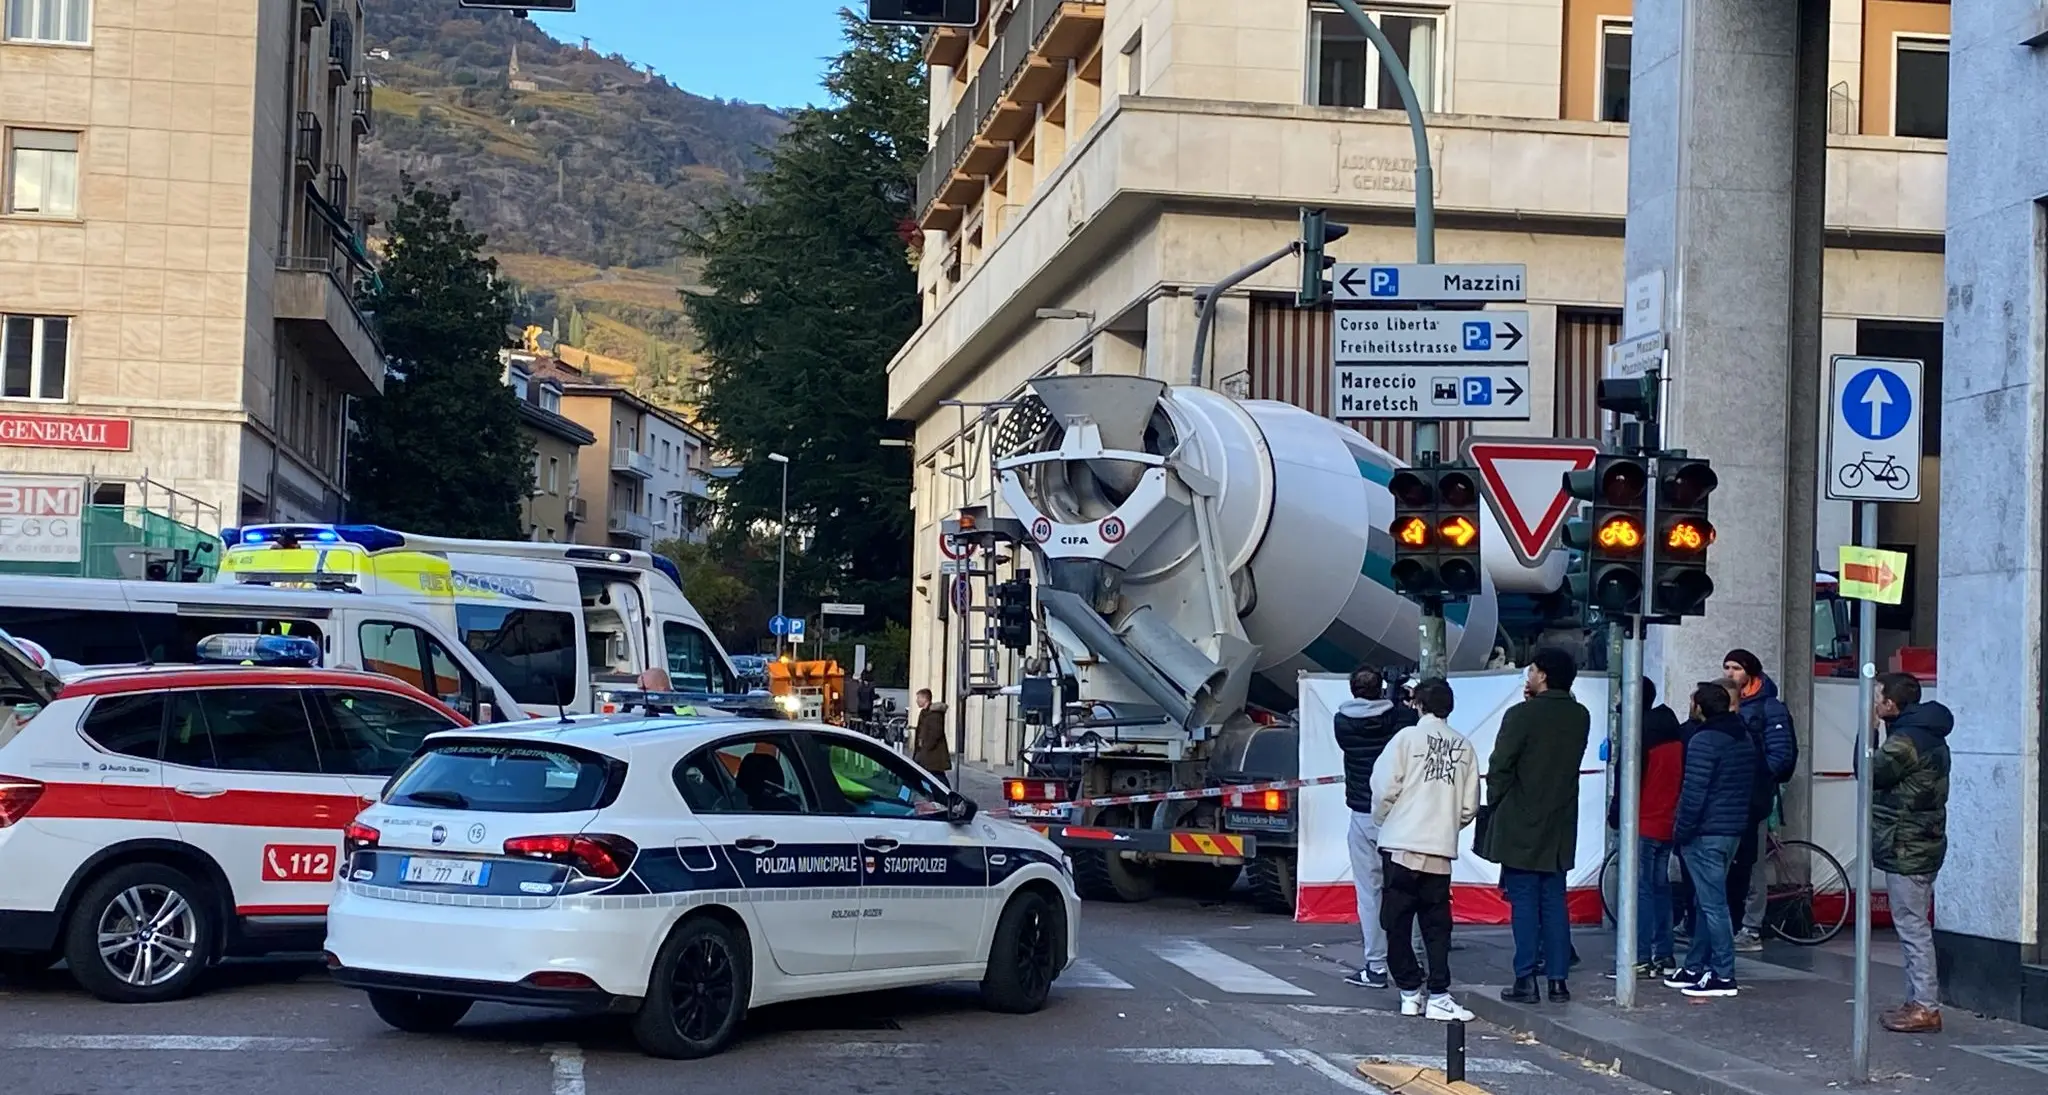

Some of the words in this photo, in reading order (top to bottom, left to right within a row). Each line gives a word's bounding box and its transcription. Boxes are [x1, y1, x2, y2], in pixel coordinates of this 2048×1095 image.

[1342, 155, 1416, 172] ASSICVRAZI
[1353, 175, 1416, 192] GENERAL
[1444, 274, 1521, 292] Mazzini
[1340, 318, 1379, 331] Corso
[1340, 340, 1458, 354] Freiheitsstrasse
[1341, 372, 1416, 389] Mareccio
[1341, 394, 1419, 412] Maretsch
[0, 420, 107, 443] GENERALI
[0, 488, 78, 515] BINI
[1036, 524, 1047, 536] 40
[1105, 524, 1118, 536] 60
[1060, 536, 1089, 545] CIFA
[472, 828, 482, 839] 15
[290, 854, 329, 875] 112
[755, 856, 796, 875] POLIZIA
[798, 855, 858, 874] MUNICIPALE
[883, 857, 947, 874] STADTPOLIZEI
[411, 865, 422, 880] YA
[434, 867, 452, 881] 777
[462, 870, 476, 884] AK
[831, 908, 859, 920] BOLZANO
